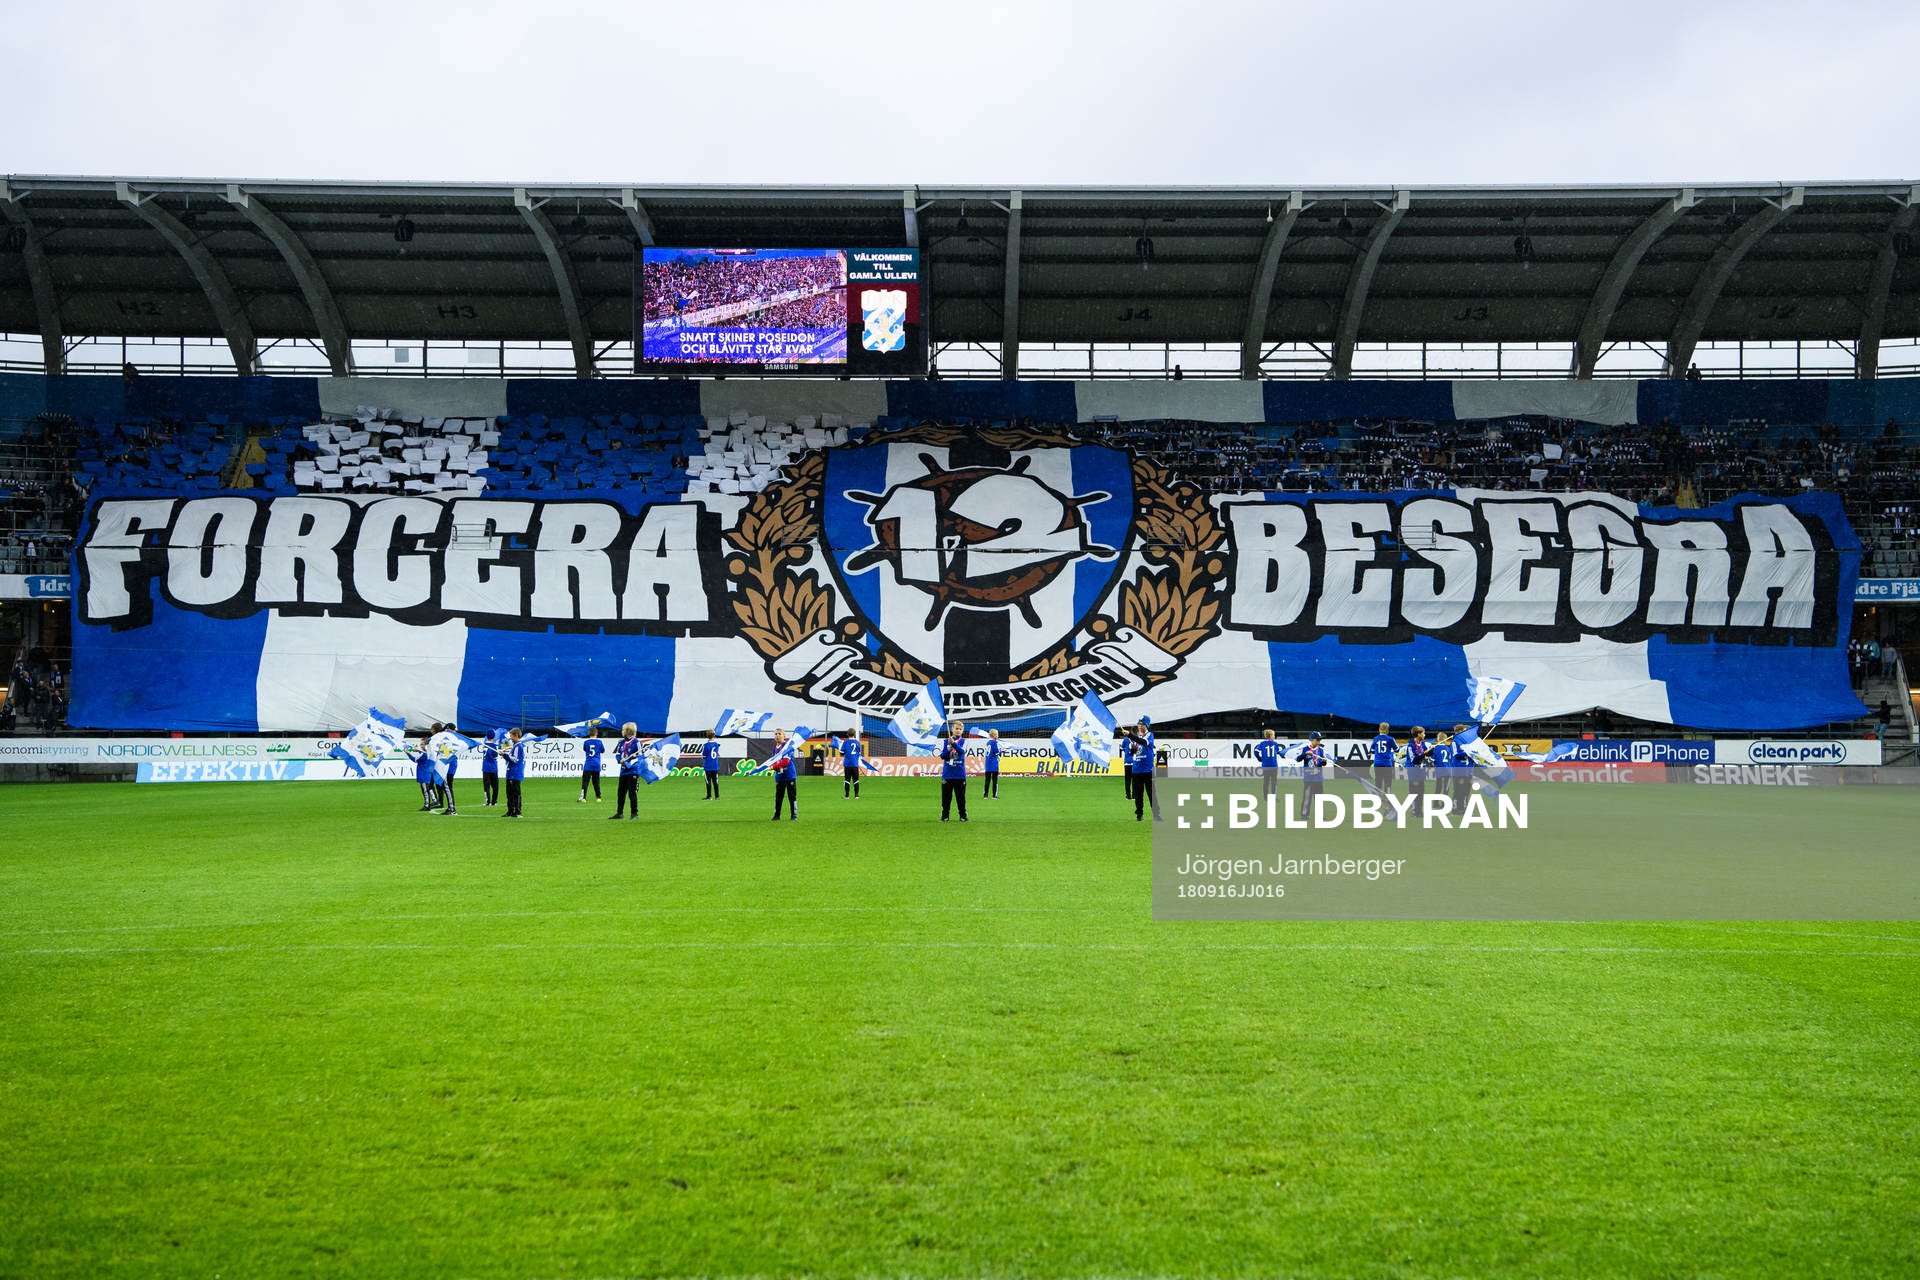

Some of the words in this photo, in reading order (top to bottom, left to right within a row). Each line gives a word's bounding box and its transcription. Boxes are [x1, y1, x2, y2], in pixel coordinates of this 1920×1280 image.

[853, 251, 913, 262] VÄLKOMMEN
[872, 262, 894, 271] TILL
[849, 271, 883, 280] GAMLA
[884, 271, 917, 280] ULLEVI
[436, 305, 476, 319] H3
[679, 332, 716, 343] SNART
[718, 332, 755, 343] SKINER
[758, 332, 815, 344] POSEIDON
[681, 344, 706, 354] OCH
[709, 341, 753, 354] BLÅVITT
[755, 341, 782, 354] STÅR
[785, 344, 813, 354] KVAR
[84, 496, 710, 621] FORCERA
[1229, 498, 1816, 629] BESEGRA
[1891, 582, 1920, 597] Fjä
[532, 739, 575, 754] STÄD
[588, 744, 596, 757] 5
[710, 746, 717, 760] 6
[850, 742, 857, 755] 2
[1265, 744, 1275, 758] 11
[1375, 740, 1387, 754] 15
[1655, 744, 1710, 761] Phone
[1752, 743, 1799, 759] clean
[1801, 743, 1843, 761] park
[1440, 749, 1448, 763] 2
[531, 761, 607, 772] ProfilMone
[1529, 763, 1634, 784] Scandic
[1693, 764, 1809, 786] SERNEKE
